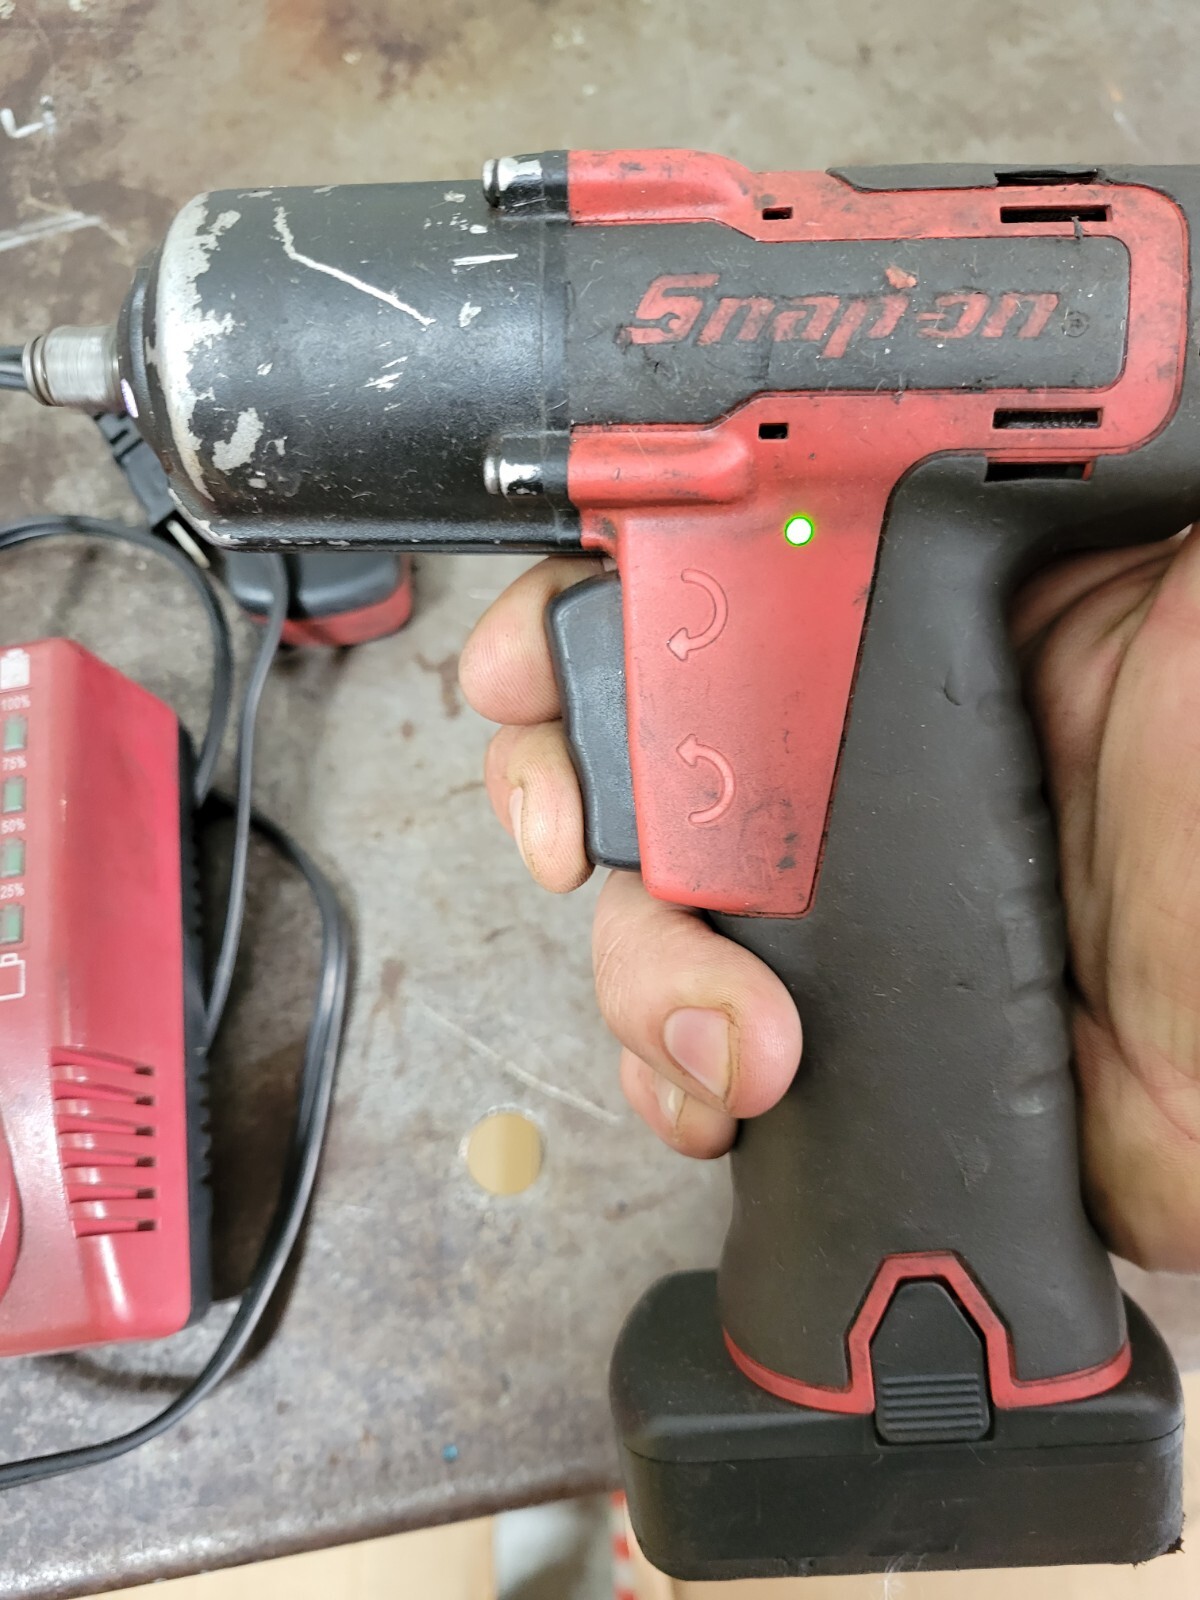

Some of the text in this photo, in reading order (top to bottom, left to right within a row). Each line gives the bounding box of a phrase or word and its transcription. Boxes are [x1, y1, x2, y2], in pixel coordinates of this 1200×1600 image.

[618, 268, 1060, 359] Snap-on
[1, 694, 31, 711] 100%
[2, 755, 27, 771] 75%
[0, 817, 26, 834] 50%
[0, 882, 25, 899] 25%
